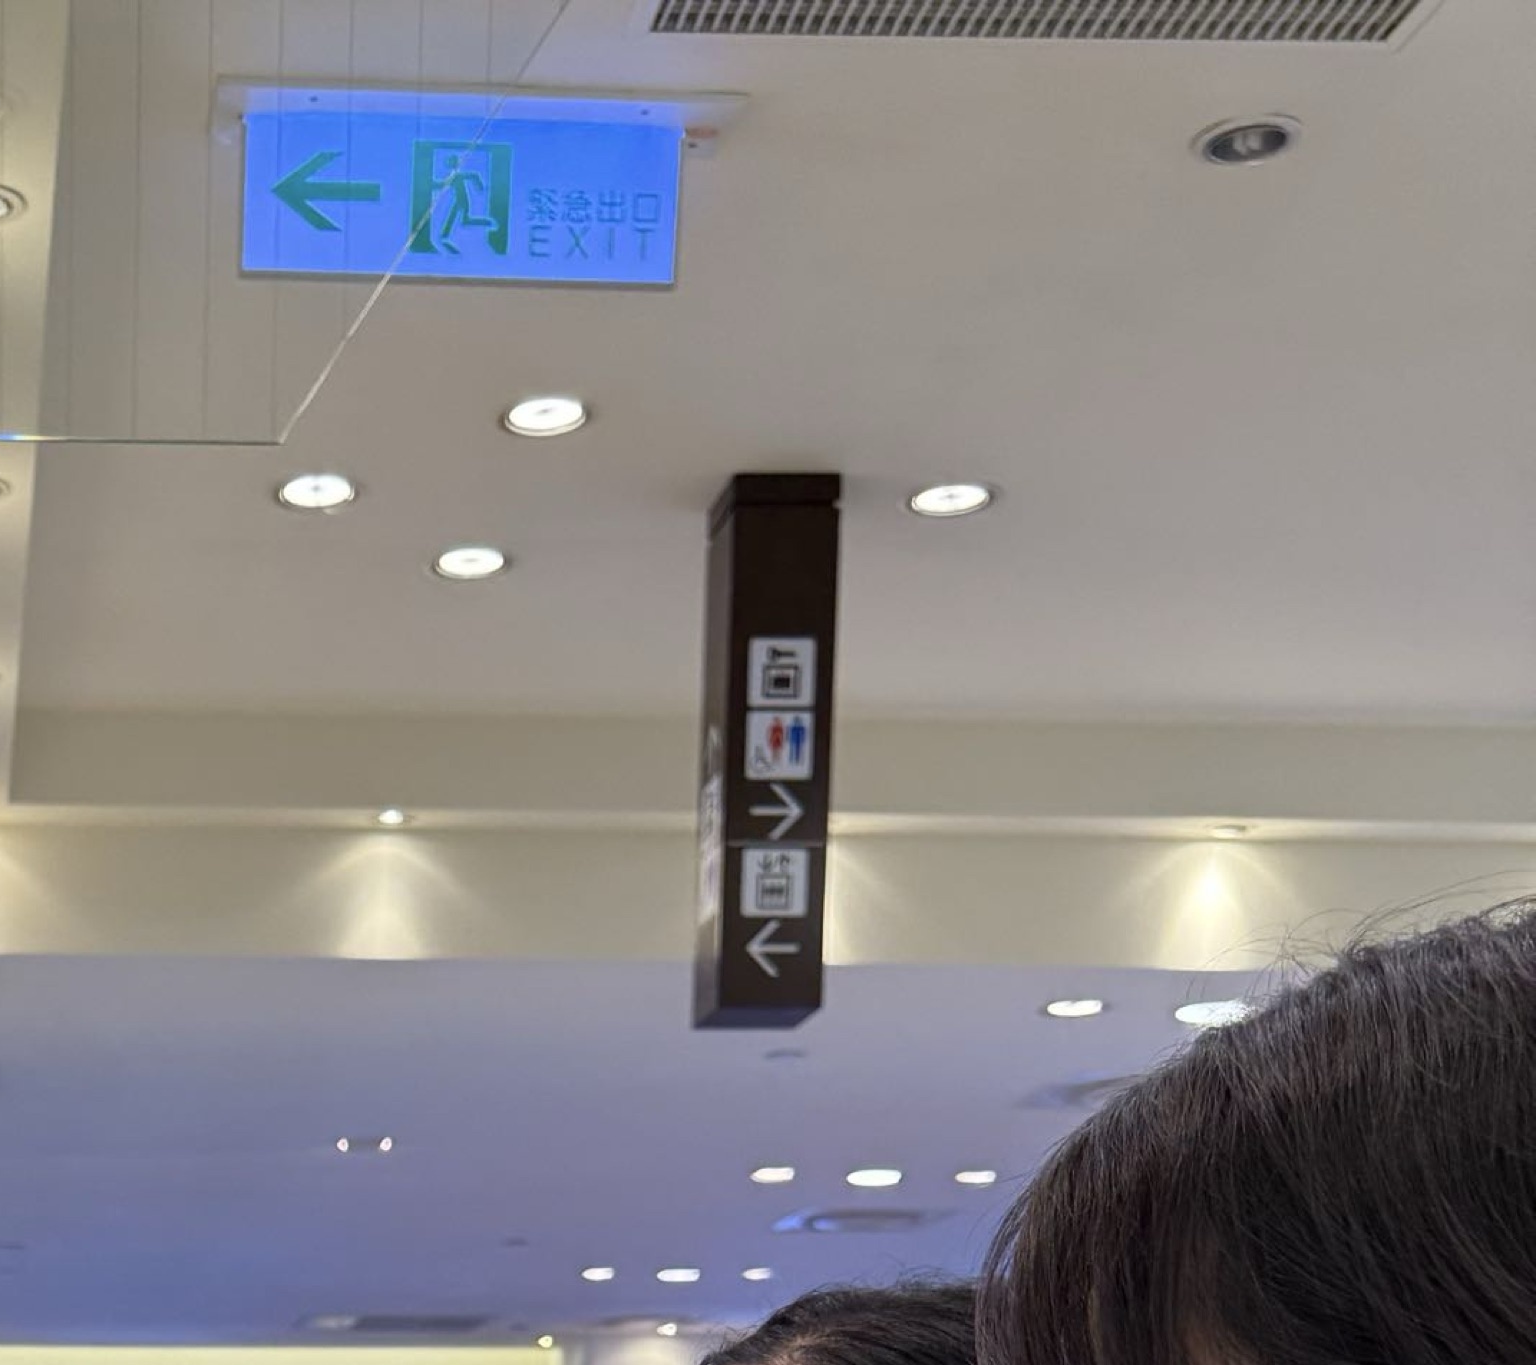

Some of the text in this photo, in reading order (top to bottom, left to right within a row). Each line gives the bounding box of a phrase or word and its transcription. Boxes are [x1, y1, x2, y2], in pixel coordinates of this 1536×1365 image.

[527, 187, 662, 226] 緊急出口
[528, 225, 653, 260] EXIT
